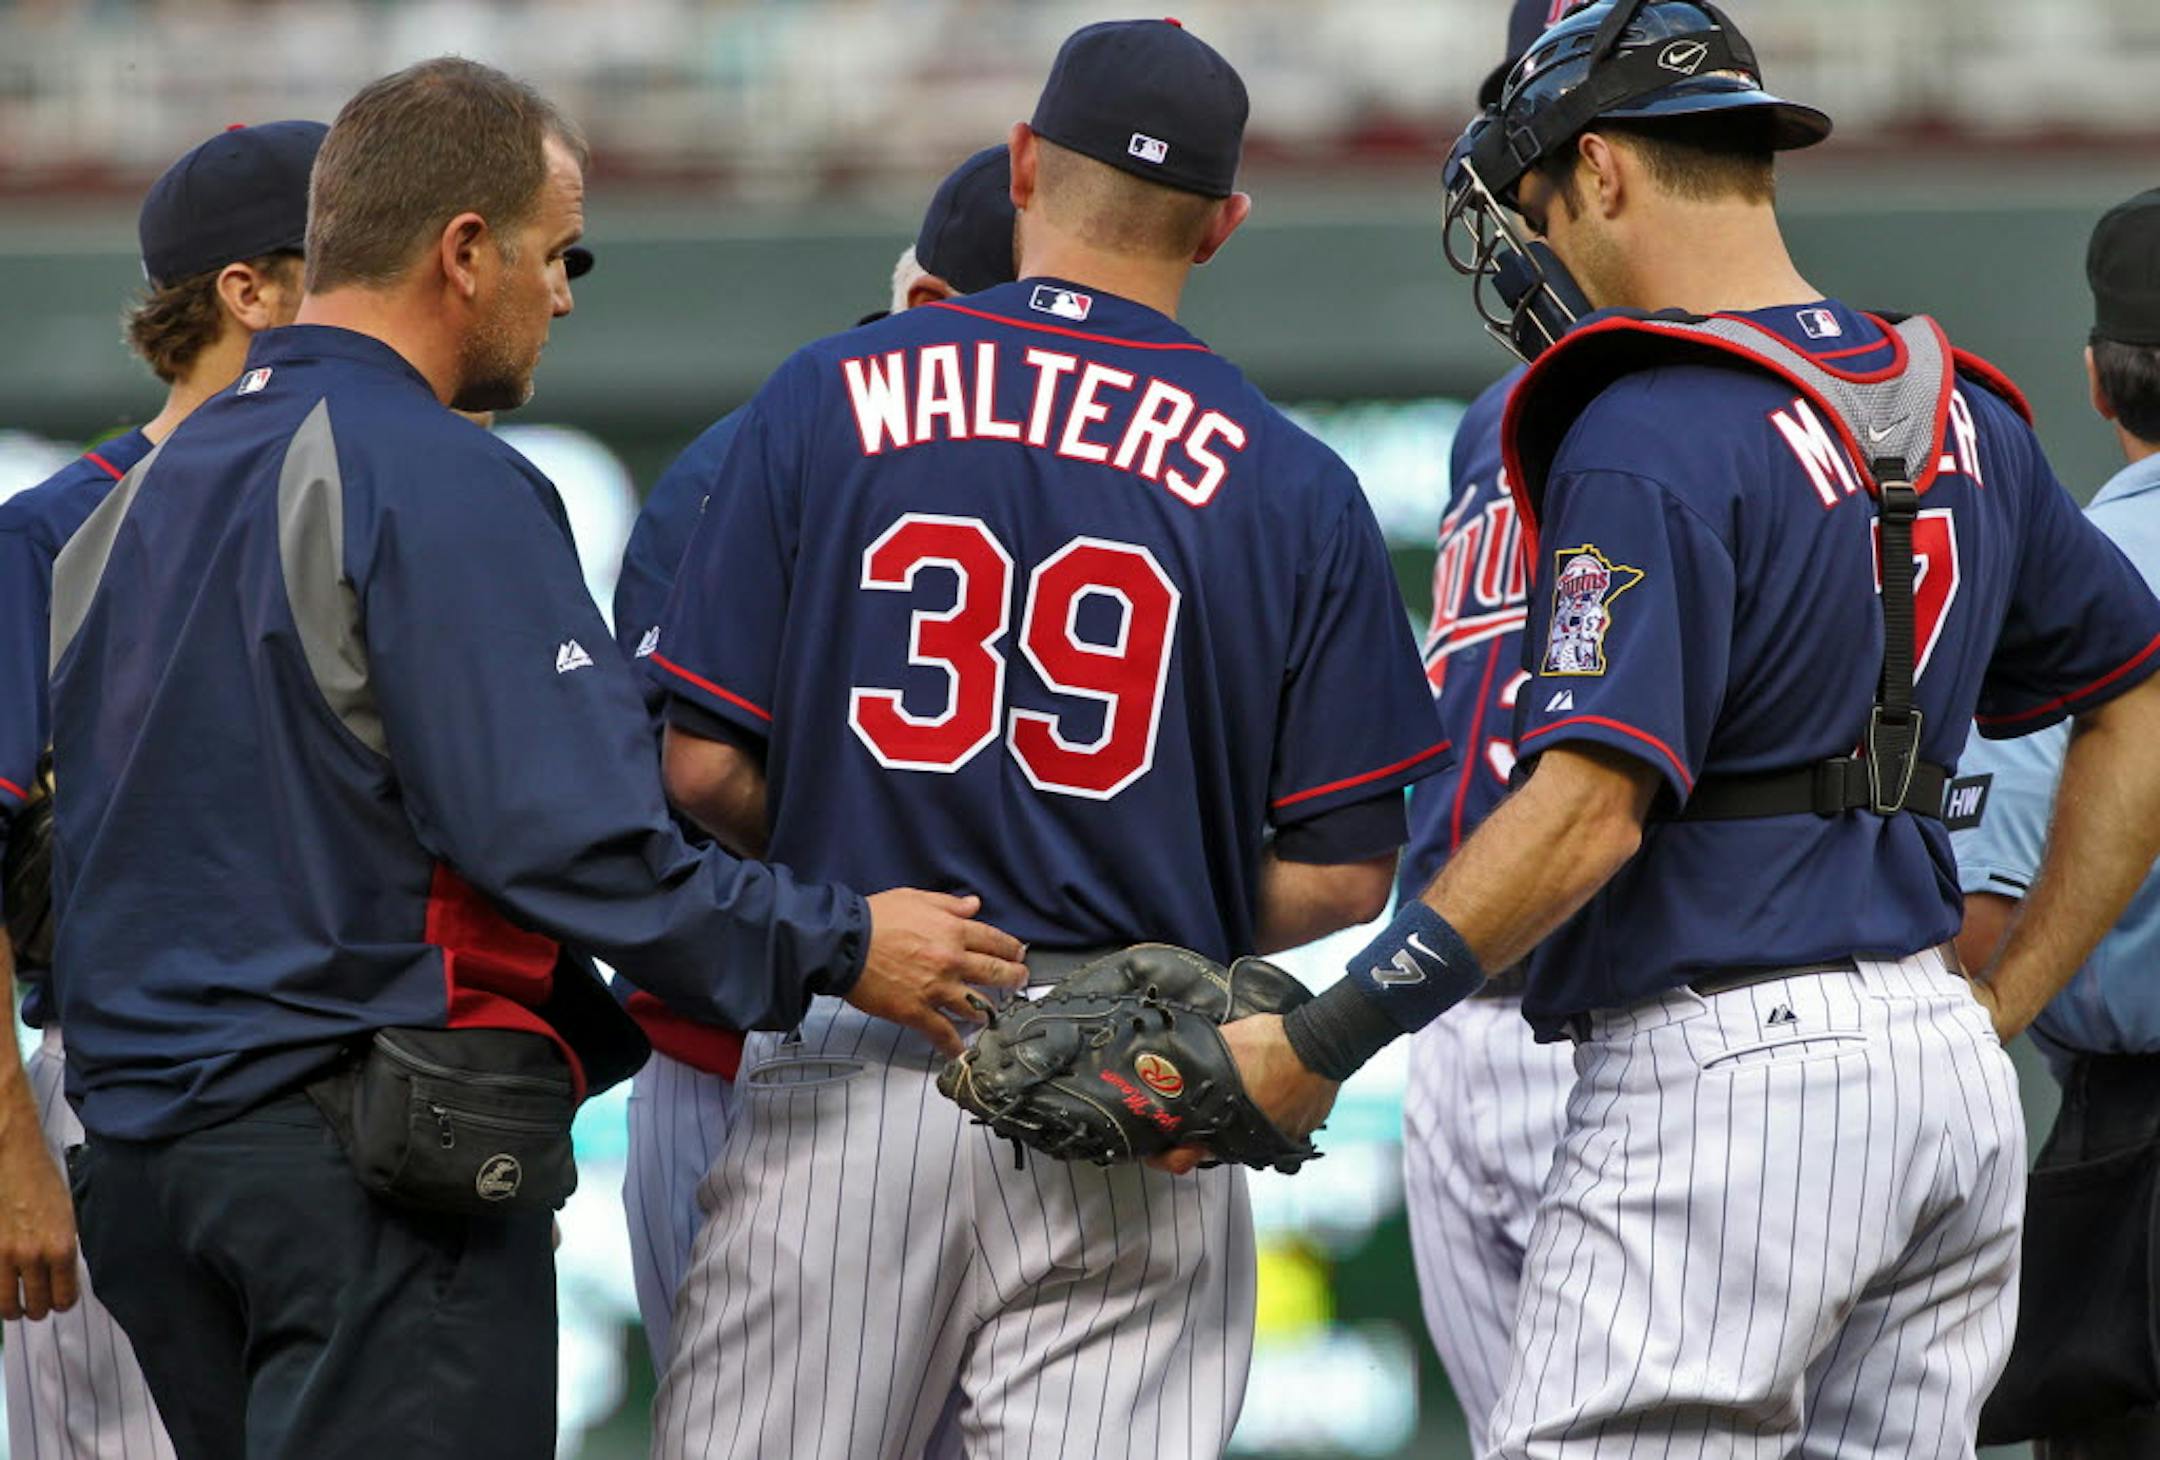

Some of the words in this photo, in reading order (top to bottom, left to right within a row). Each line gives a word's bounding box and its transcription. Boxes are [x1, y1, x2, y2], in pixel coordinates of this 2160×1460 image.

[842, 340, 1248, 508] WALTERS
[848, 512, 1181, 801] 39
[1947, 786, 1985, 819] HW
[1370, 948, 1427, 990] 7
